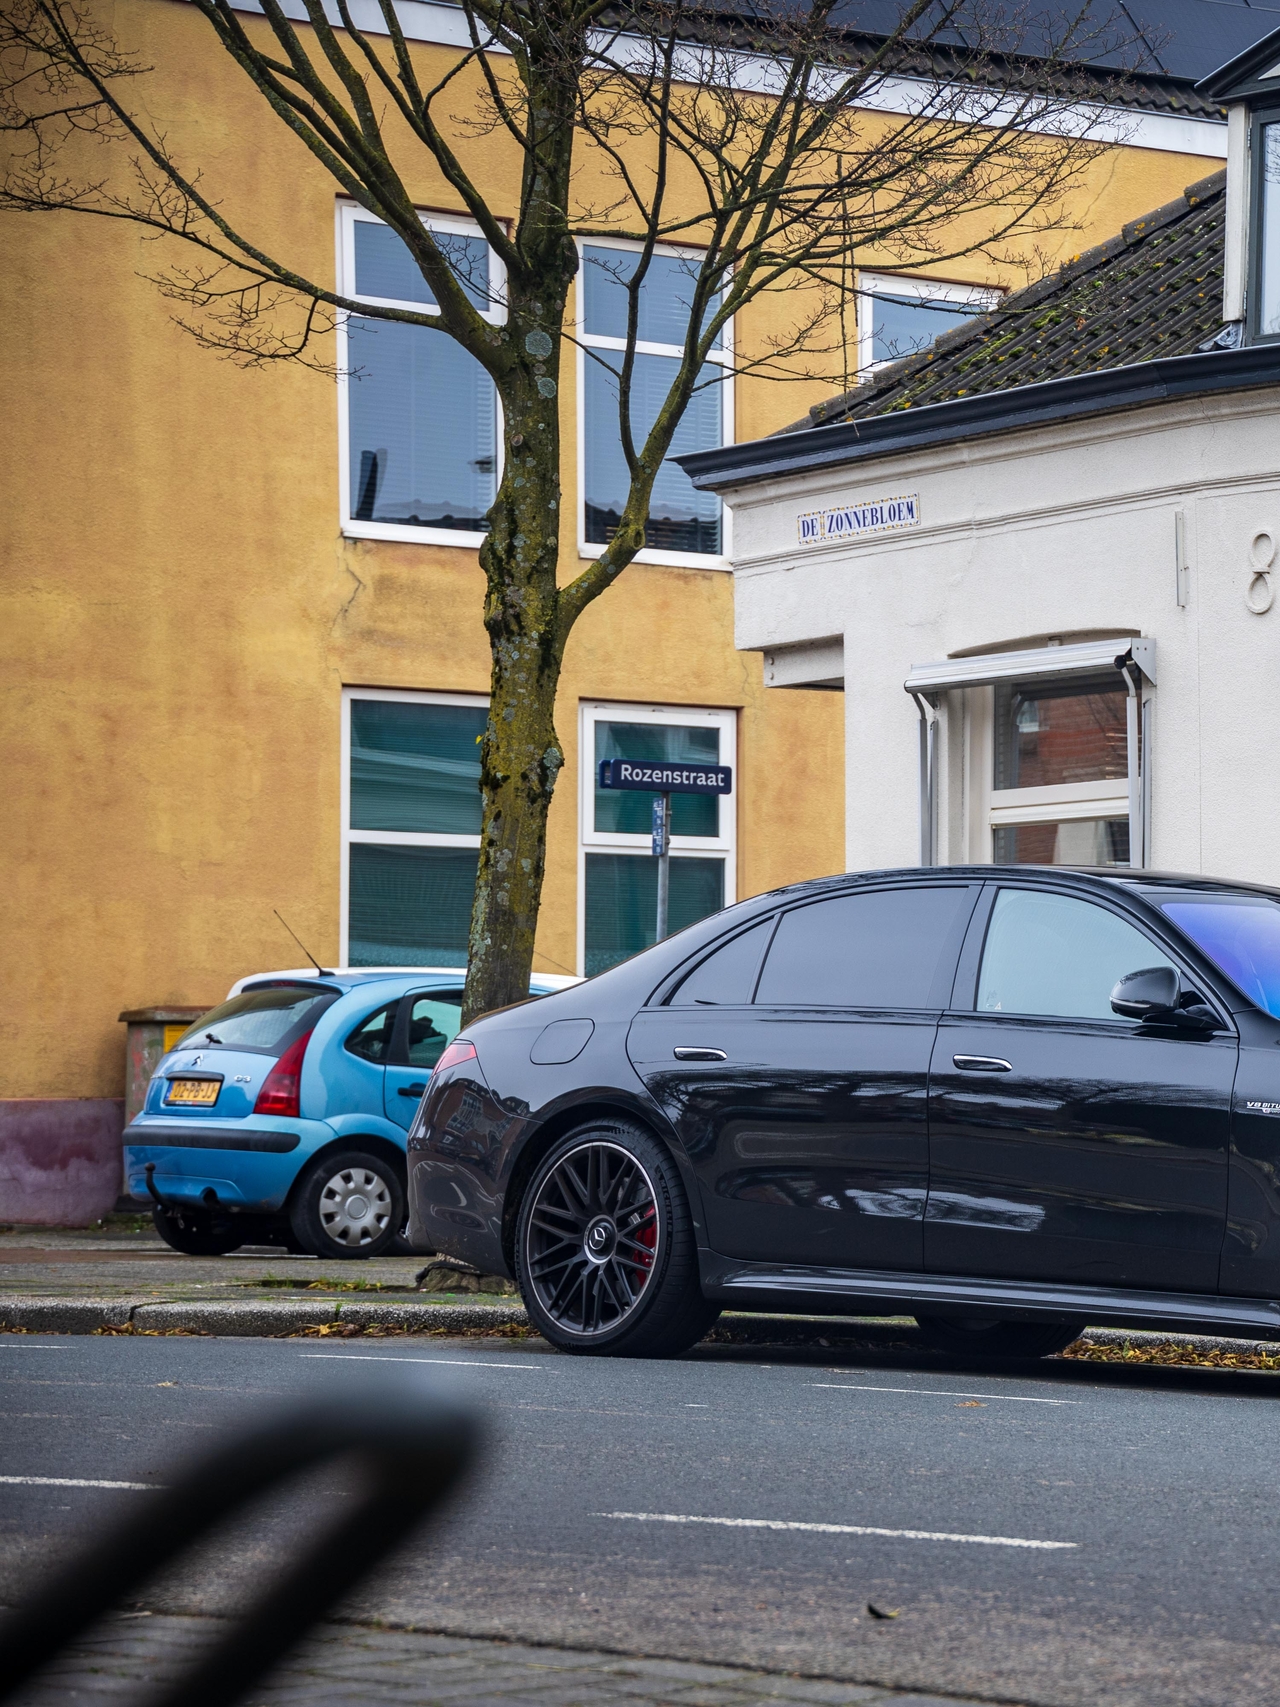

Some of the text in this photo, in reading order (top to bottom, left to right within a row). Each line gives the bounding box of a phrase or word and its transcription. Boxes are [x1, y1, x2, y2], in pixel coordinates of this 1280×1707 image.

[801, 500, 916, 538] DE ZONNEBLOEM
[620, 764, 725, 787] Rozenstraat
[234, 1075, 251, 1083] C3
[659, 1179, 673, 1233] MICHELIN
